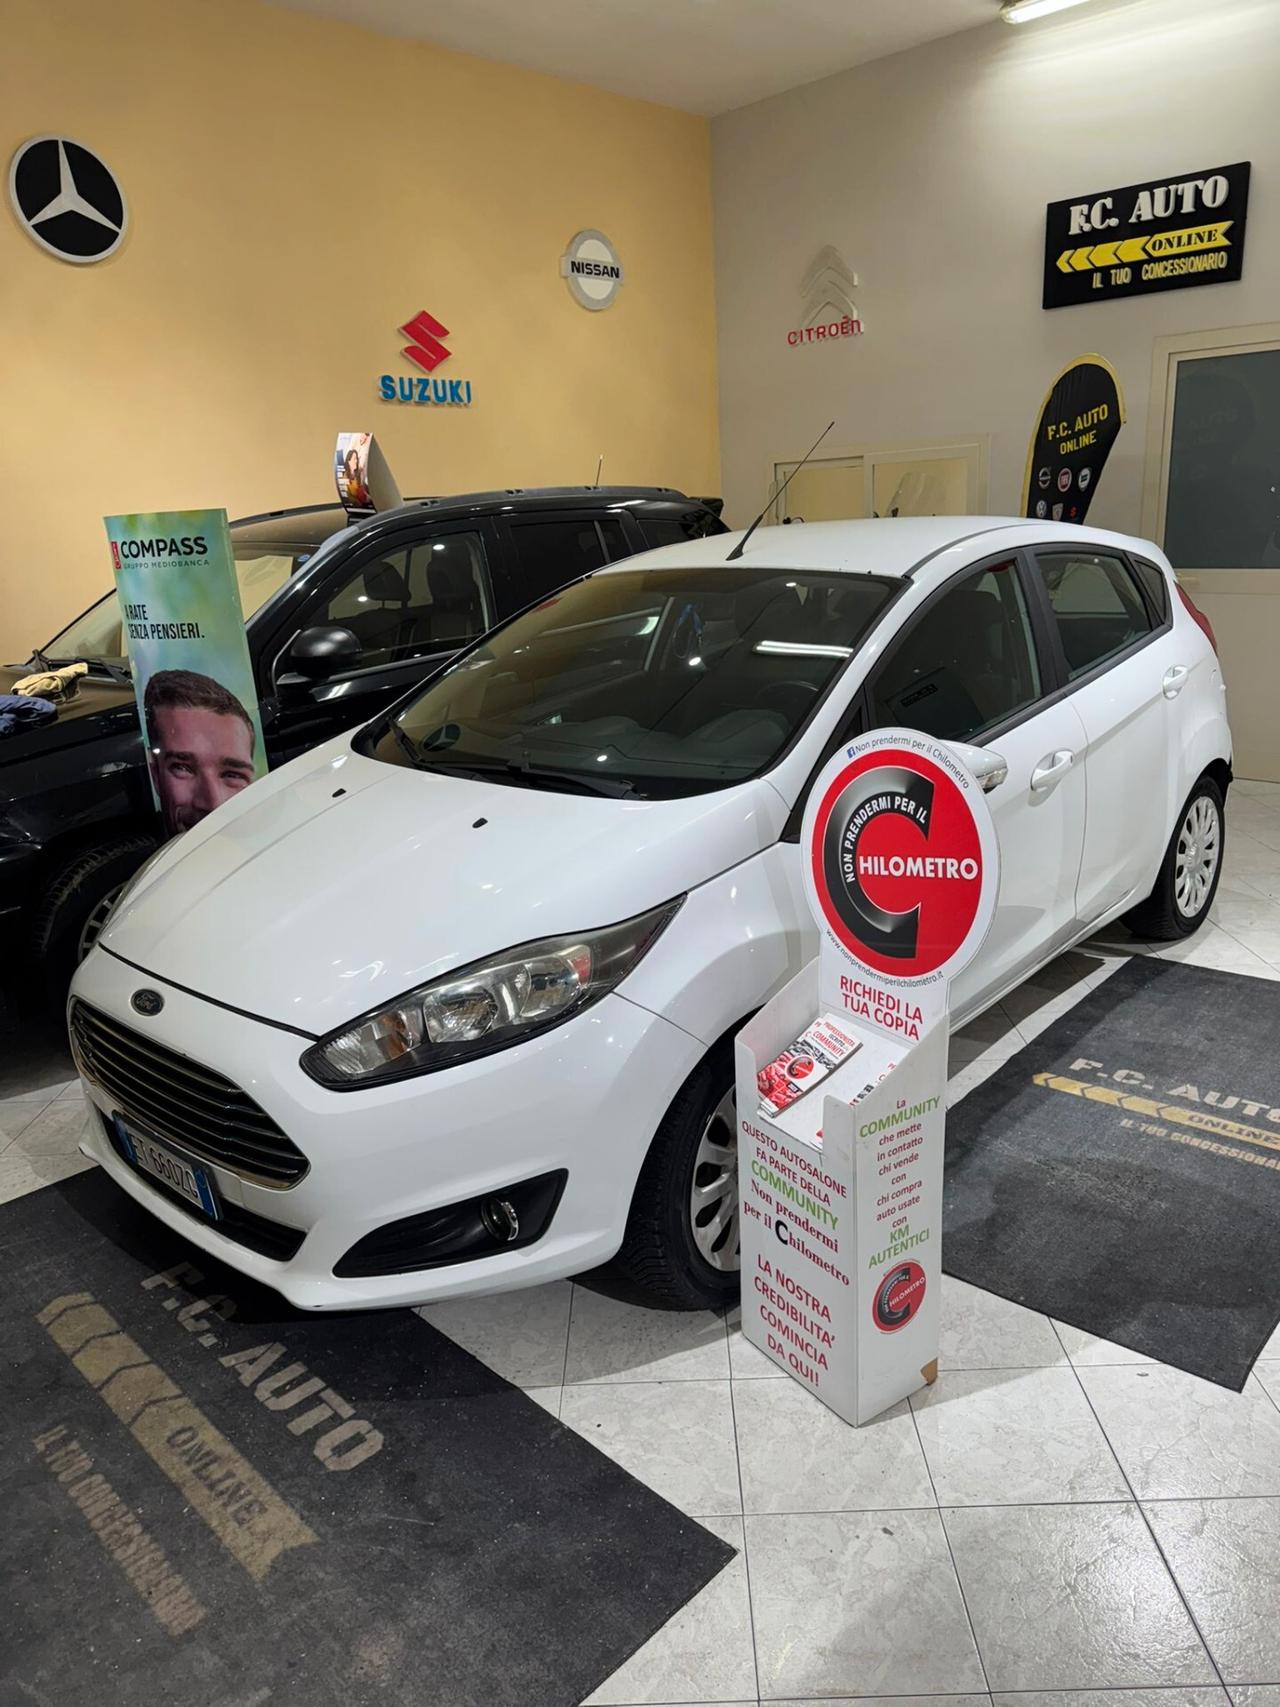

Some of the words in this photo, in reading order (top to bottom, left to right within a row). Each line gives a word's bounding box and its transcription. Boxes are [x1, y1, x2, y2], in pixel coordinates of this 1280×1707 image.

[1067, 196, 1119, 235] F.C.
[1128, 175, 1229, 223] AUTO
[1151, 228, 1219, 252] ONLINE
[571, 260, 620, 278] NISSAN
[1092, 272, 1103, 288] IL
[1110, 266, 1132, 285] TUO
[1141, 251, 1227, 280] CONCESSIONARIO
[379, 374, 472, 403] SUZUKI
[1047, 422, 1072, 440] F.C.
[1074, 403, 1108, 432] AUTO
[1059, 430, 1097, 455] ONLINE
[120, 536, 208, 559] COMPASS
[151, 559, 210, 567] MEDIOBANCA
[128, 604, 148, 620] RATE
[150, 622, 205, 639] PENSIERI.
[855, 742, 870, 752] Non
[871, 735, 911, 748] prendermi
[912, 739, 926, 750] per
[926, 744, 932, 753] il
[932, 748, 969, 789] Chilometro
[844, 796, 891, 849] PRENDERMI
[894, 796, 916, 815] PER
[916, 806, 928, 824] IL
[843, 853, 856, 883] NON
[826, 928, 944, 988] www.nonprendermiperilchilometro.it
[839, 975, 901, 1014] RICHIEDI
[905, 1002, 923, 1024] LA
[842, 993, 870, 1018] TUA
[874, 1008, 920, 1041] COPIA
[813, 1030, 846, 1057] COMMUNITY
[860, 1095, 941, 1138] COMMUNITY
[896, 1099, 906, 1109] La
[877, 1151, 886, 1162] in
[887, 1136, 923, 1158] contatto
[879, 1132, 894, 1146] che
[897, 1122, 922, 1137] mette
[1120, 1119, 1134, 1129] IL
[1170, 1131, 1280, 1171] CONCESSIONA
[742, 1120, 777, 1151] QUESTO
[780, 1145, 847, 1199] AUTOSALONE
[756, 1147, 767, 1163] FA
[769, 1155, 797, 1184] PARTE
[800, 1176, 831, 1207] DELLA
[878, 1162, 891, 1176] chi
[893, 1151, 919, 1170] vende
[751, 1160, 839, 1231] COMMUNITY
[877, 1193, 889, 1207] chi
[891, 1180, 922, 1201] compra
[891, 1173, 907, 1185] con
[751, 1179, 772, 1205] Non
[776, 1200, 839, 1253] prendermi
[876, 1207, 896, 1221] auto
[898, 1195, 921, 1211] usate
[892, 1215, 907, 1228] con
[743, 1201, 761, 1220] per
[764, 1213, 772, 1229] il
[775, 1219, 850, 1287] Chilometro
[868, 1228, 930, 1269] AUTENTICI
[890, 1224, 910, 1244] KM
[758, 1254, 772, 1277] LA
[776, 1268, 831, 1323] NOSTRA
[754, 1275, 835, 1349] CREDIBILITA'
[760, 1304, 828, 1371] COMINCIA
[767, 1333, 785, 1360] DA
[788, 1352, 819, 1387] QUI!
[218, 1342, 384, 1472] AUTO
[166, 1425, 269, 1527] ONLINE
